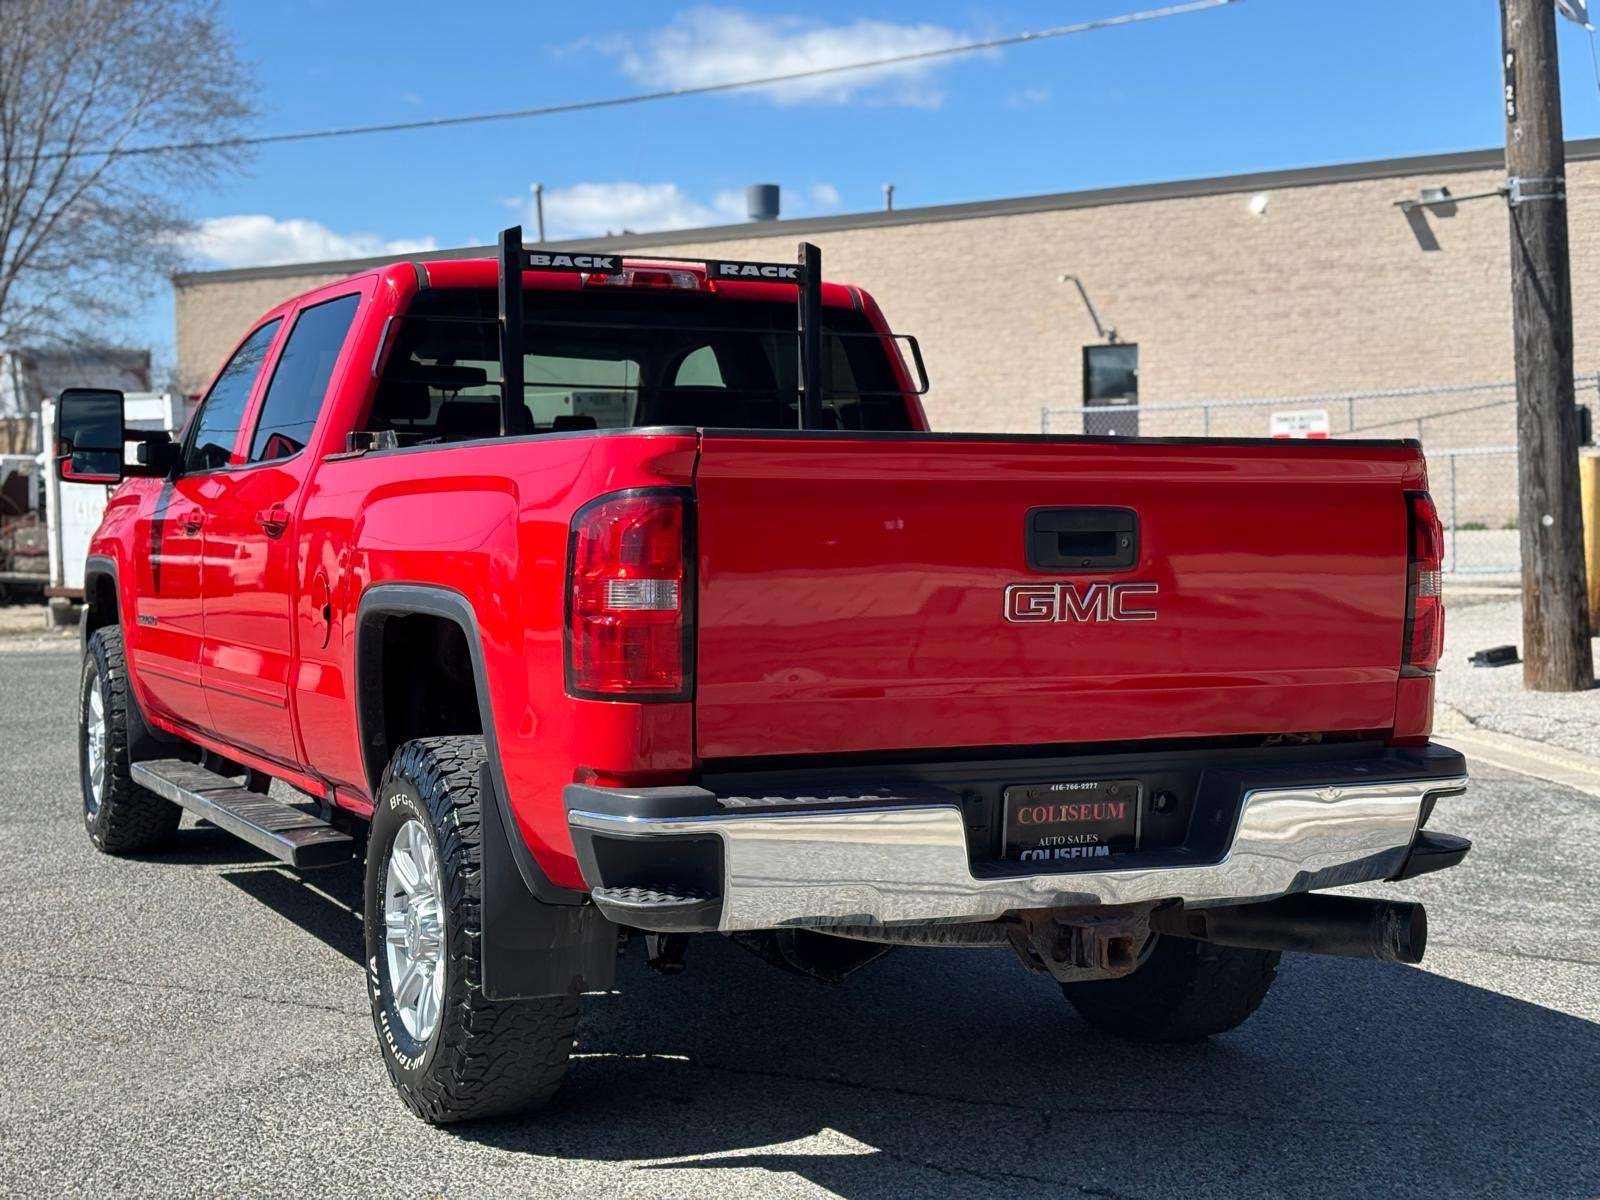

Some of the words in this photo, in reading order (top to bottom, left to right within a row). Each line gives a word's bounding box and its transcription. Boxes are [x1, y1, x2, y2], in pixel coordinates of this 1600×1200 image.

[530, 254, 614, 269] BACK
[719, 263, 798, 279] RACK
[1005, 584, 1159, 623] GMC
[1016, 802, 1127, 825] COLISEUM
[1038, 835, 1066, 847] AUTO
[1067, 833, 1099, 845] SALES
